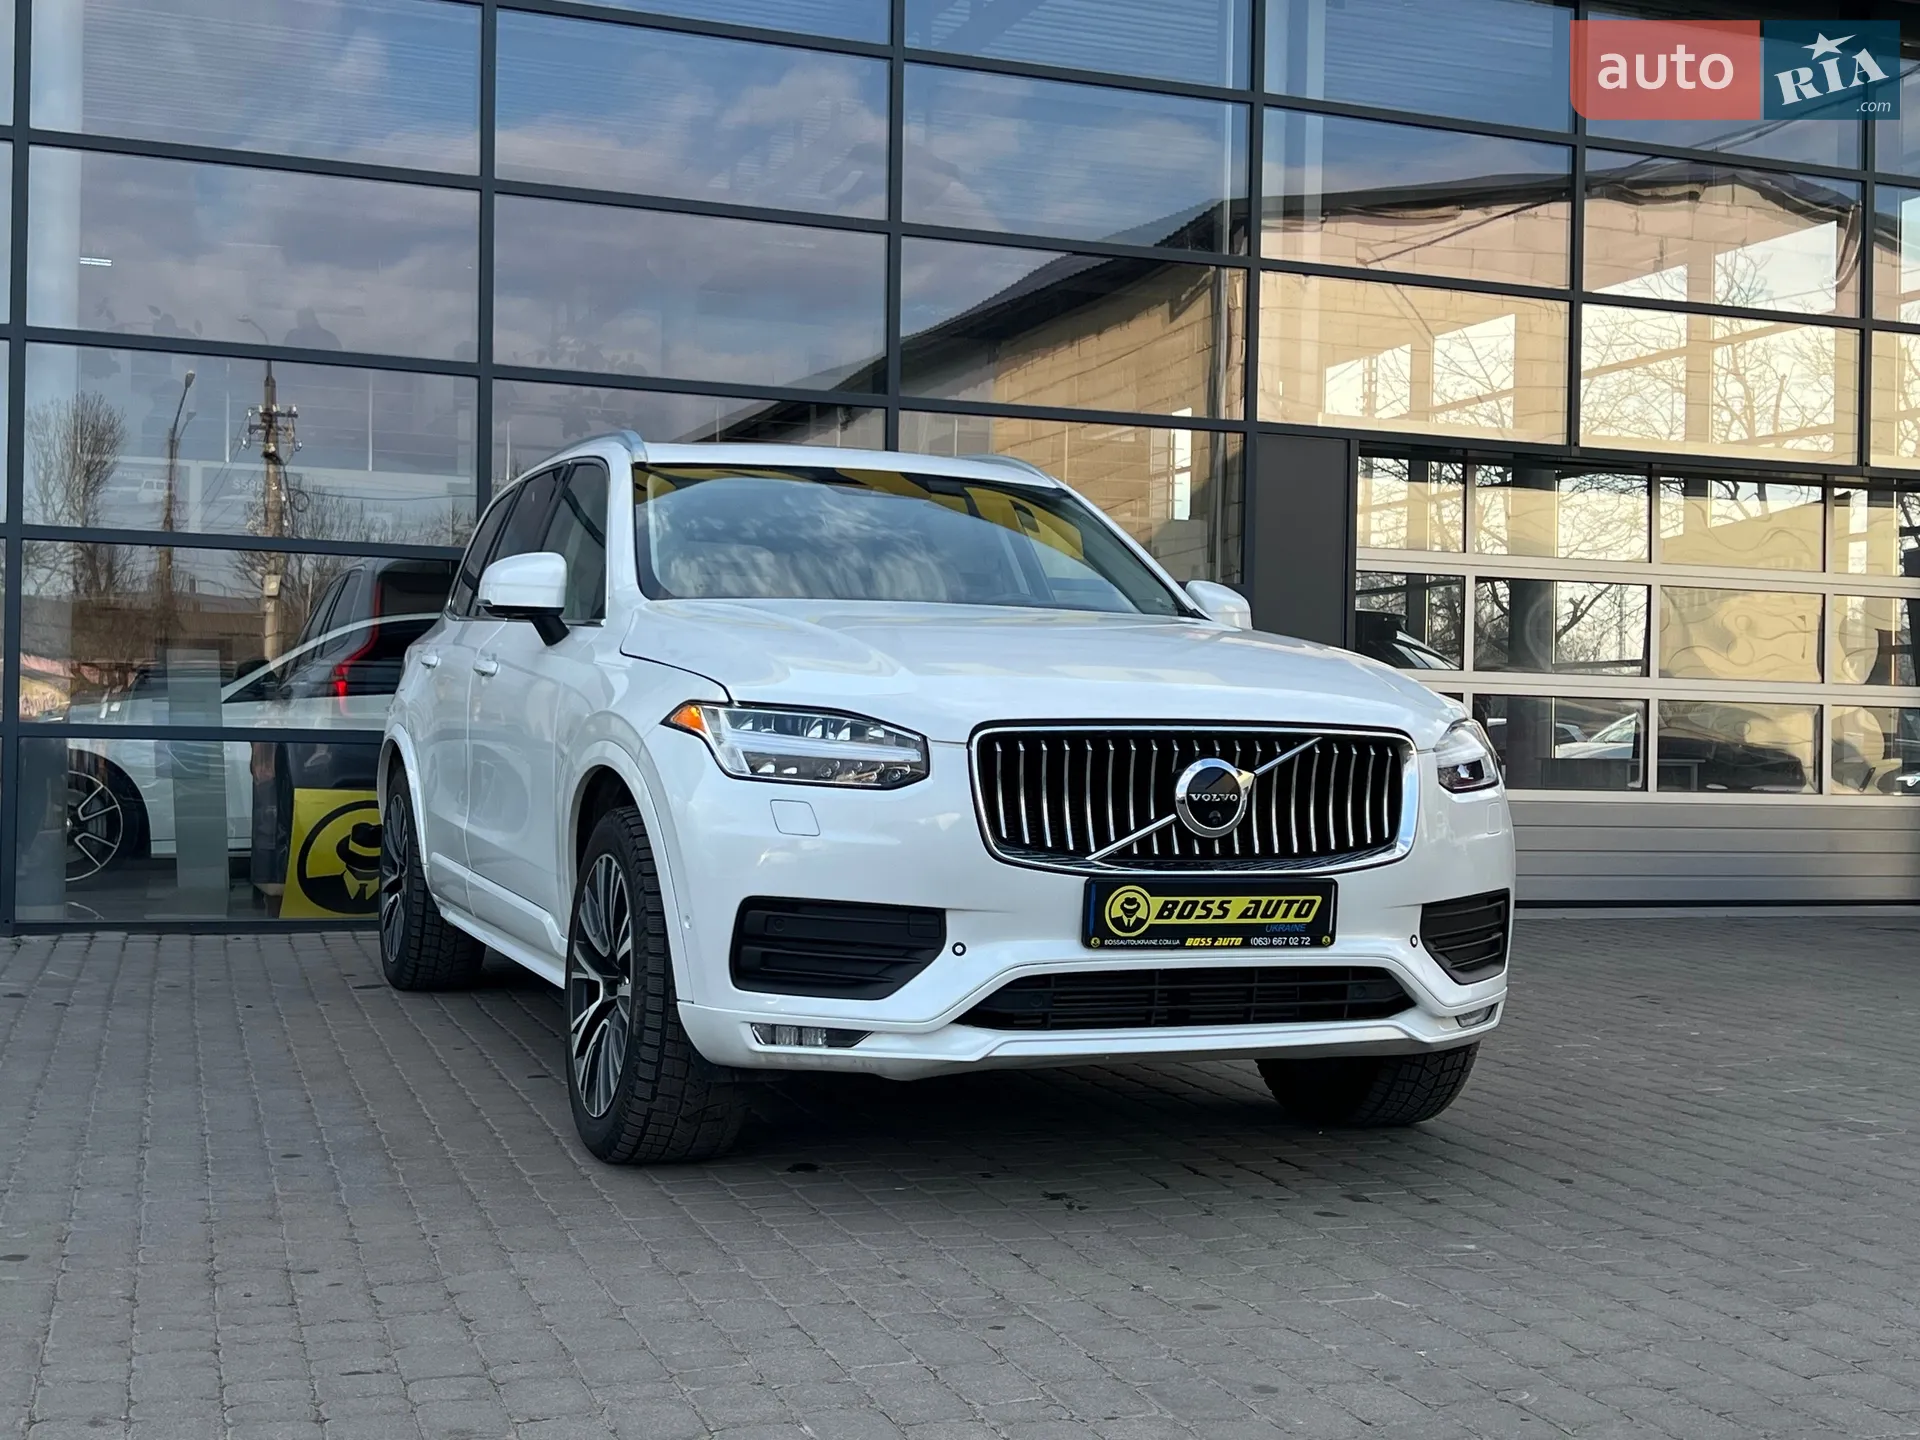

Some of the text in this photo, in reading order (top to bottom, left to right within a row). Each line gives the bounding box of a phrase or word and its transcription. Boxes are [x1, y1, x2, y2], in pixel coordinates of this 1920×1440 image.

[1189, 793, 1238, 802] VOLVO
[1154, 899, 1314, 920] BOSS AUTO
[1265, 923, 1307, 933] UKRAINE
[1185, 937, 1243, 946] BOSS AUTO
[1250, 936, 1311, 946] (063) 667 02 72
